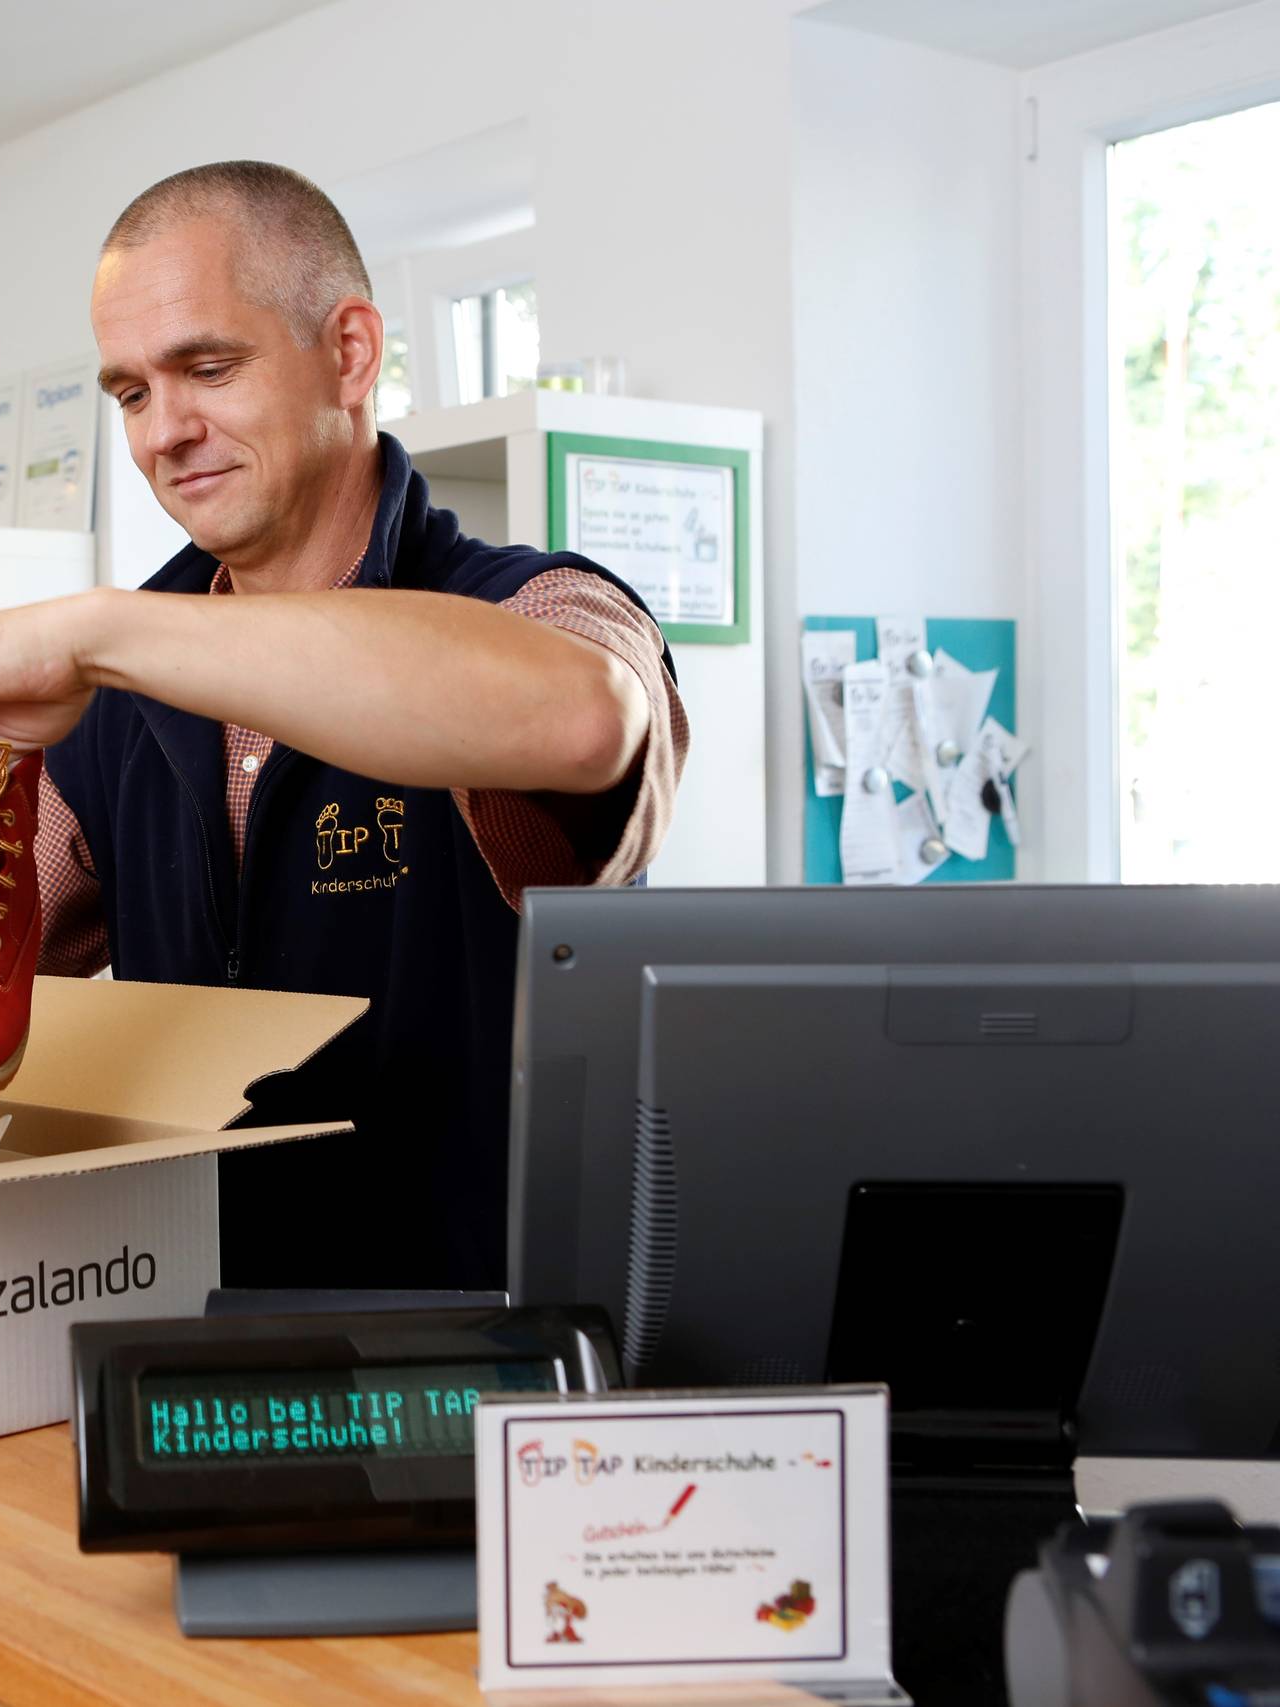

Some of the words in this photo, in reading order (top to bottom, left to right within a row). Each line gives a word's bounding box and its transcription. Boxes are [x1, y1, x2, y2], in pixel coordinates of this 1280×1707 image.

[311, 871, 399, 895] Kinderschuh
[151, 1397, 249, 1427] Hallo
[269, 1395, 324, 1424] bei
[346, 1391, 403, 1420] TIP
[424, 1387, 480, 1417] TAP
[151, 1417, 404, 1455] Kinderschuhe!
[578, 1454, 623, 1479] TAP
[634, 1452, 777, 1473] Kinderschuhe
